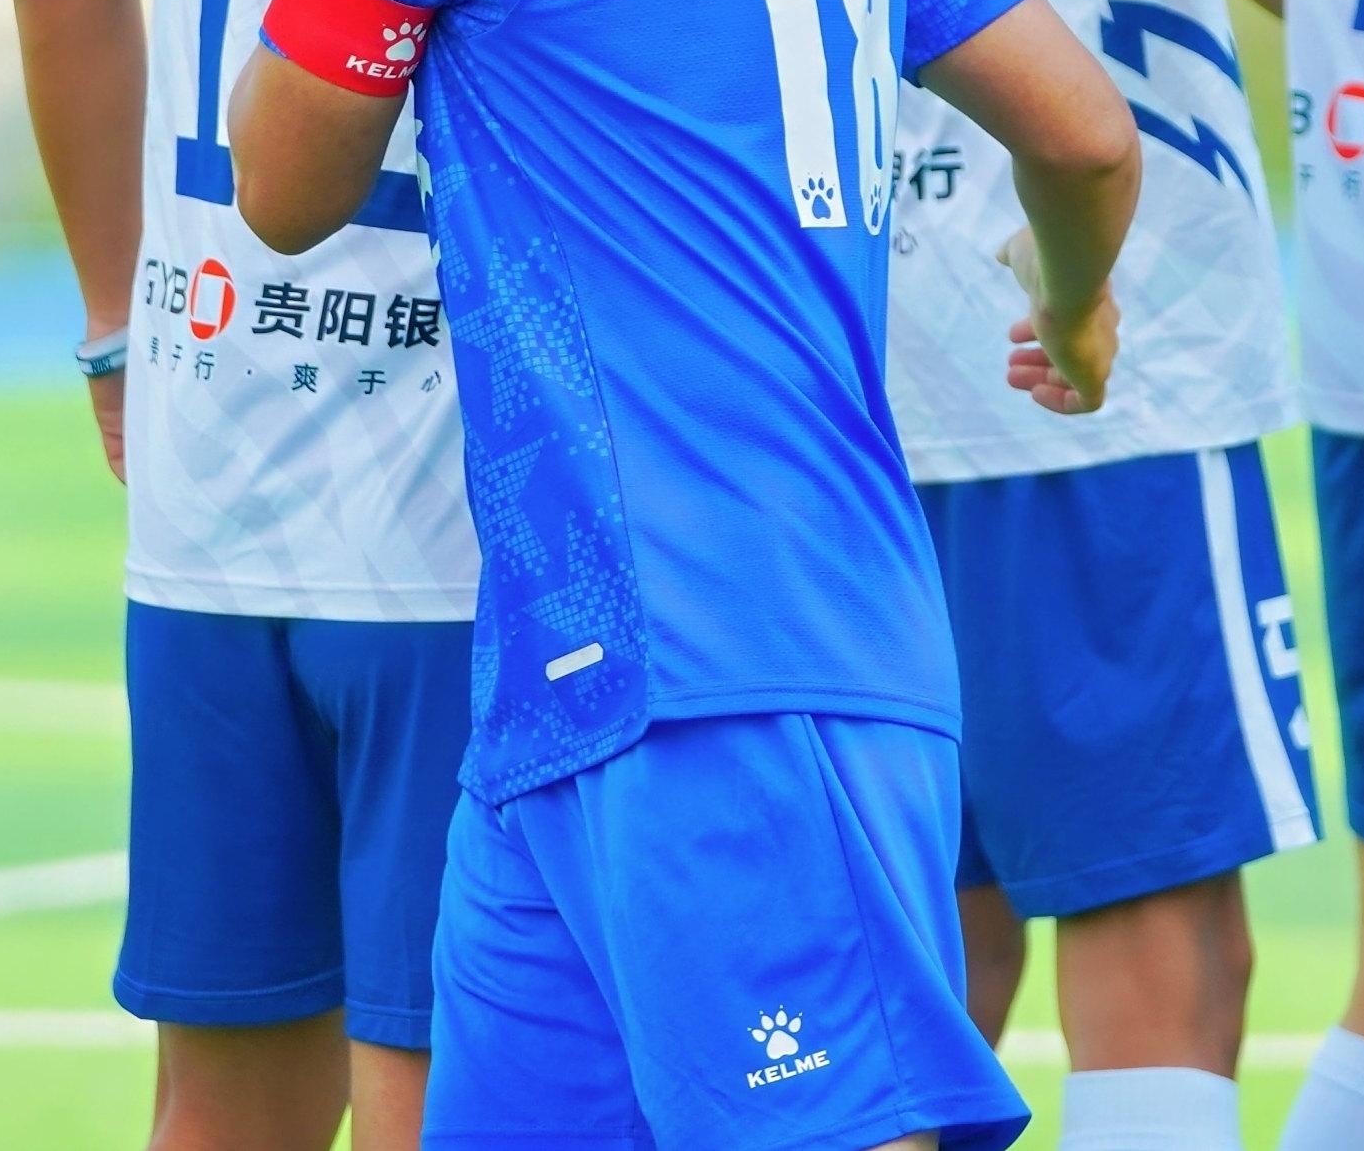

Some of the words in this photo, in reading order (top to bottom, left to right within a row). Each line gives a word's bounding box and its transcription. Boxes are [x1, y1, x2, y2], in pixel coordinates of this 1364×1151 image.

[345, 54, 420, 79] KELM
[251, 281, 443, 349] 贵阳银
[746, 1049, 831, 1090] KELME
